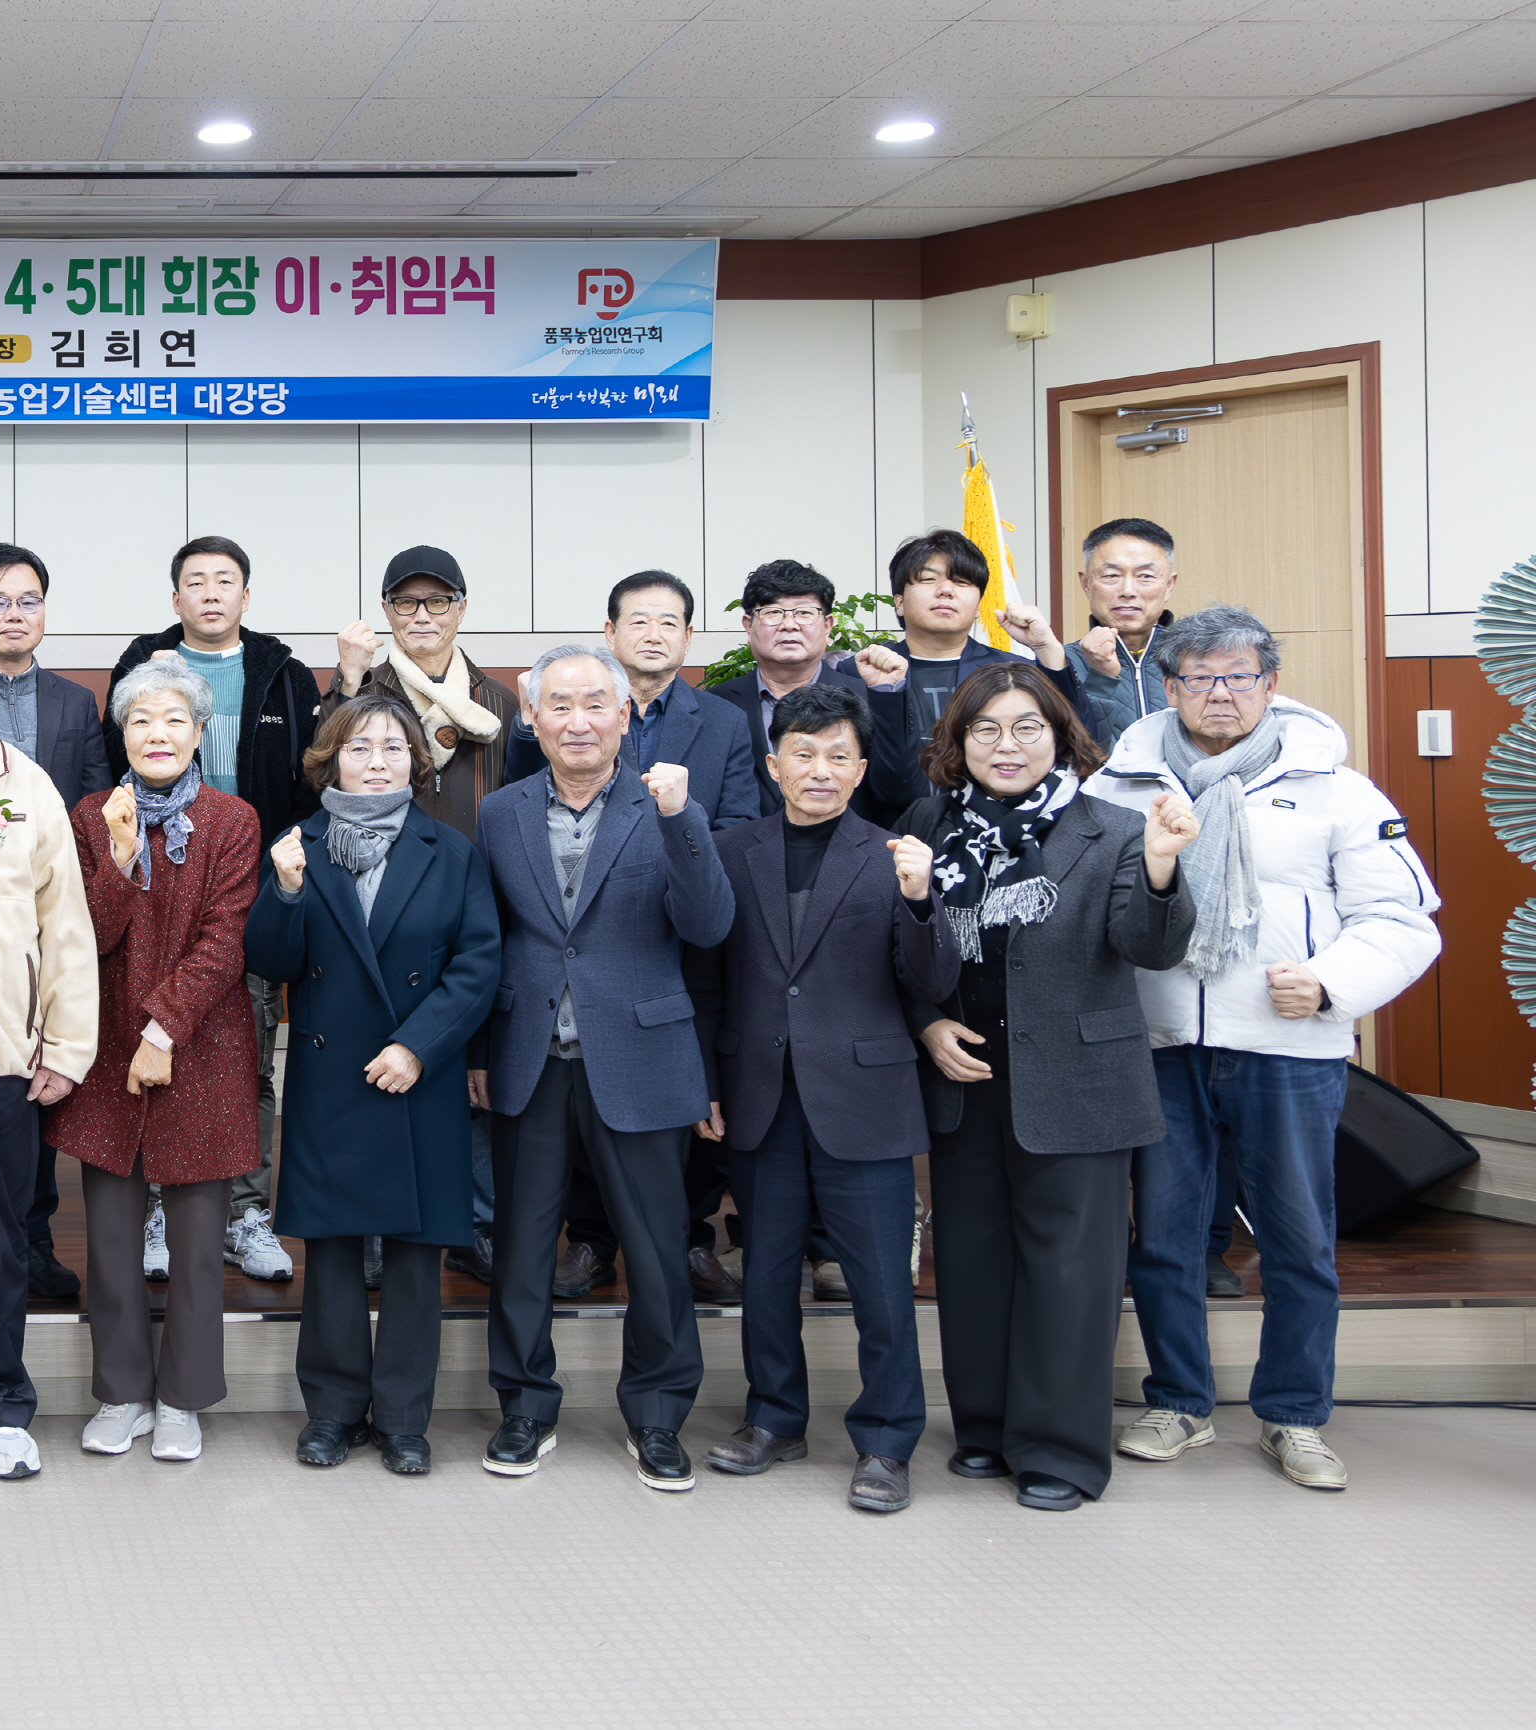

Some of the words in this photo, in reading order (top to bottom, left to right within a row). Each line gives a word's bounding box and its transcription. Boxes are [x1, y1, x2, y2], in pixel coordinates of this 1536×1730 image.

[161, 255, 260, 316] 회장
[543, 325, 663, 344] 품목농업인연구회
[561, 347, 591, 356] Farmer's
[592, 346, 622, 355] Research
[623, 346, 645, 356] Group
[194, 381, 289, 415] 대강당
[531, 386, 573, 409] 더불어
[576, 387, 629, 408] 행복한
[633, 382, 679, 414] 미래
